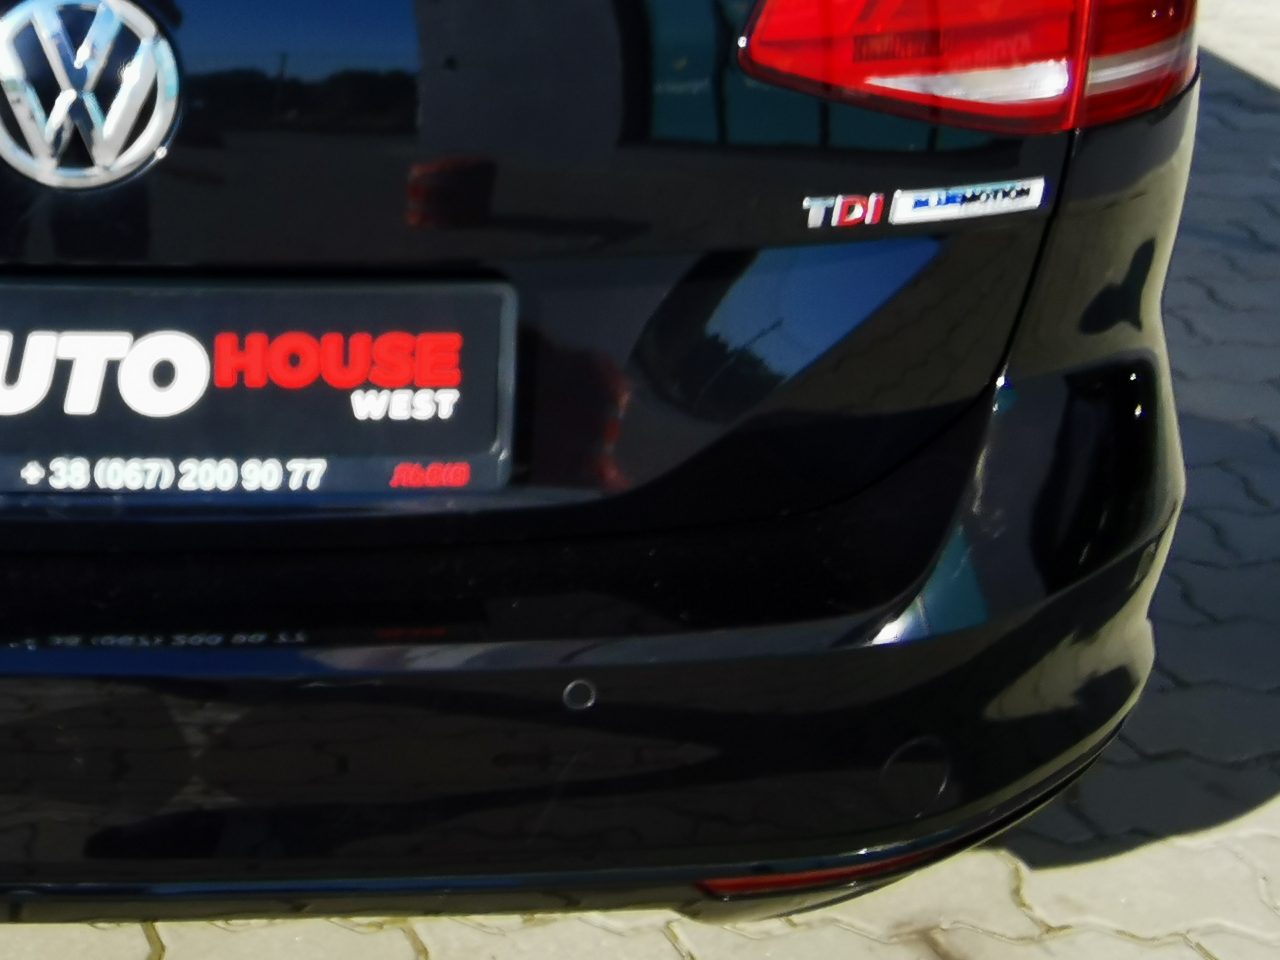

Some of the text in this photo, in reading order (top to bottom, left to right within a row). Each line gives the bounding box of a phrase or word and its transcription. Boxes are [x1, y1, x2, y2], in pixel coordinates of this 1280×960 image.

[802, 192, 886, 229] TDI
[350, 388, 460, 421] WEST
[49, 457, 91, 490] 38
[94, 458, 176, 490] (067)
[177, 458, 238, 491] 200
[241, 458, 283, 491] 90
[286, 458, 327, 491] 77
